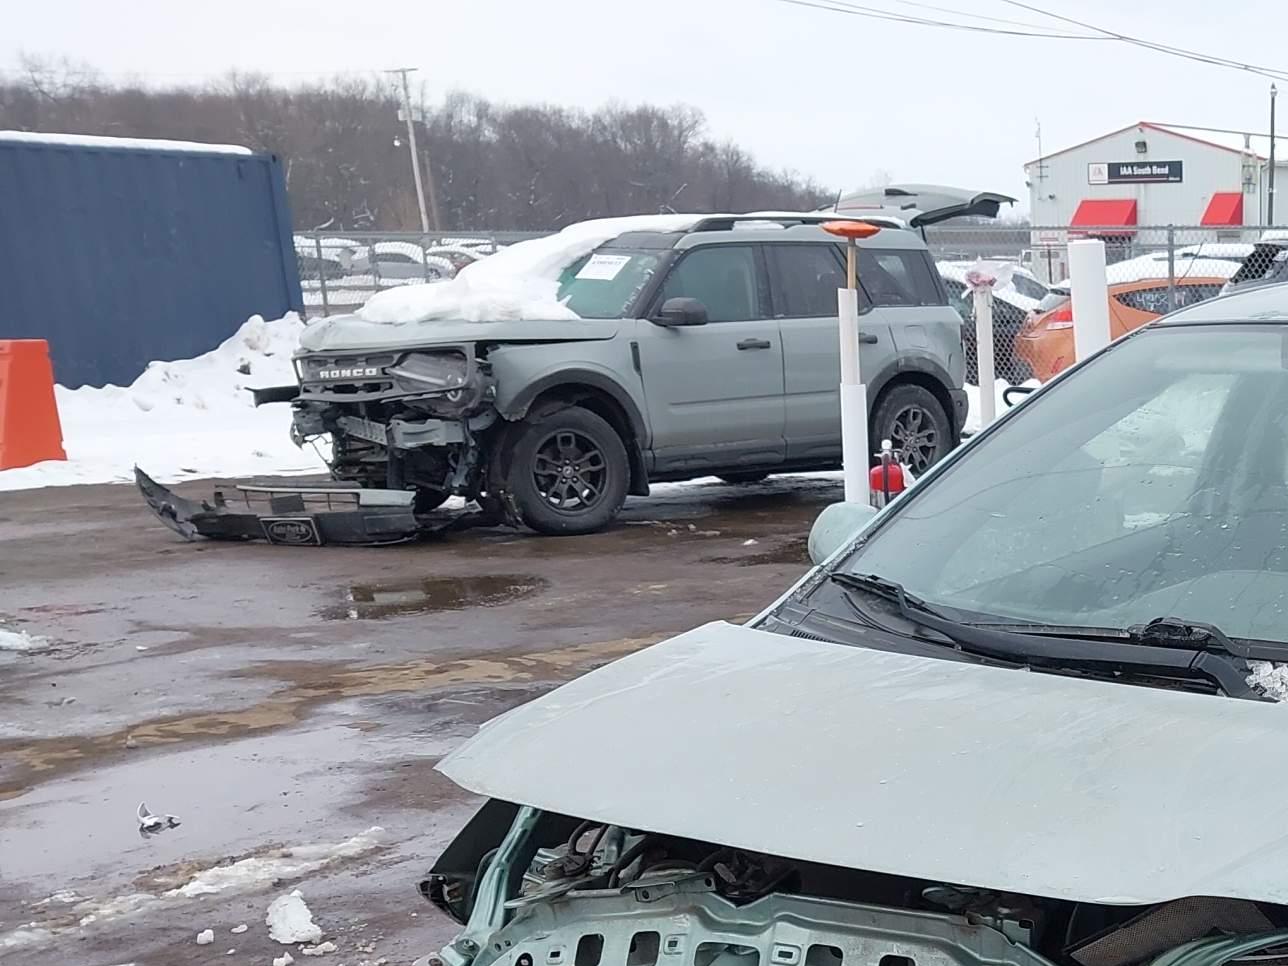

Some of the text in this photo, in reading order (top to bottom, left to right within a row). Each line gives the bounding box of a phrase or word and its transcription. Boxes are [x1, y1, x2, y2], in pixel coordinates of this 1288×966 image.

[1120, 165, 1169, 175] IAA South Bend
